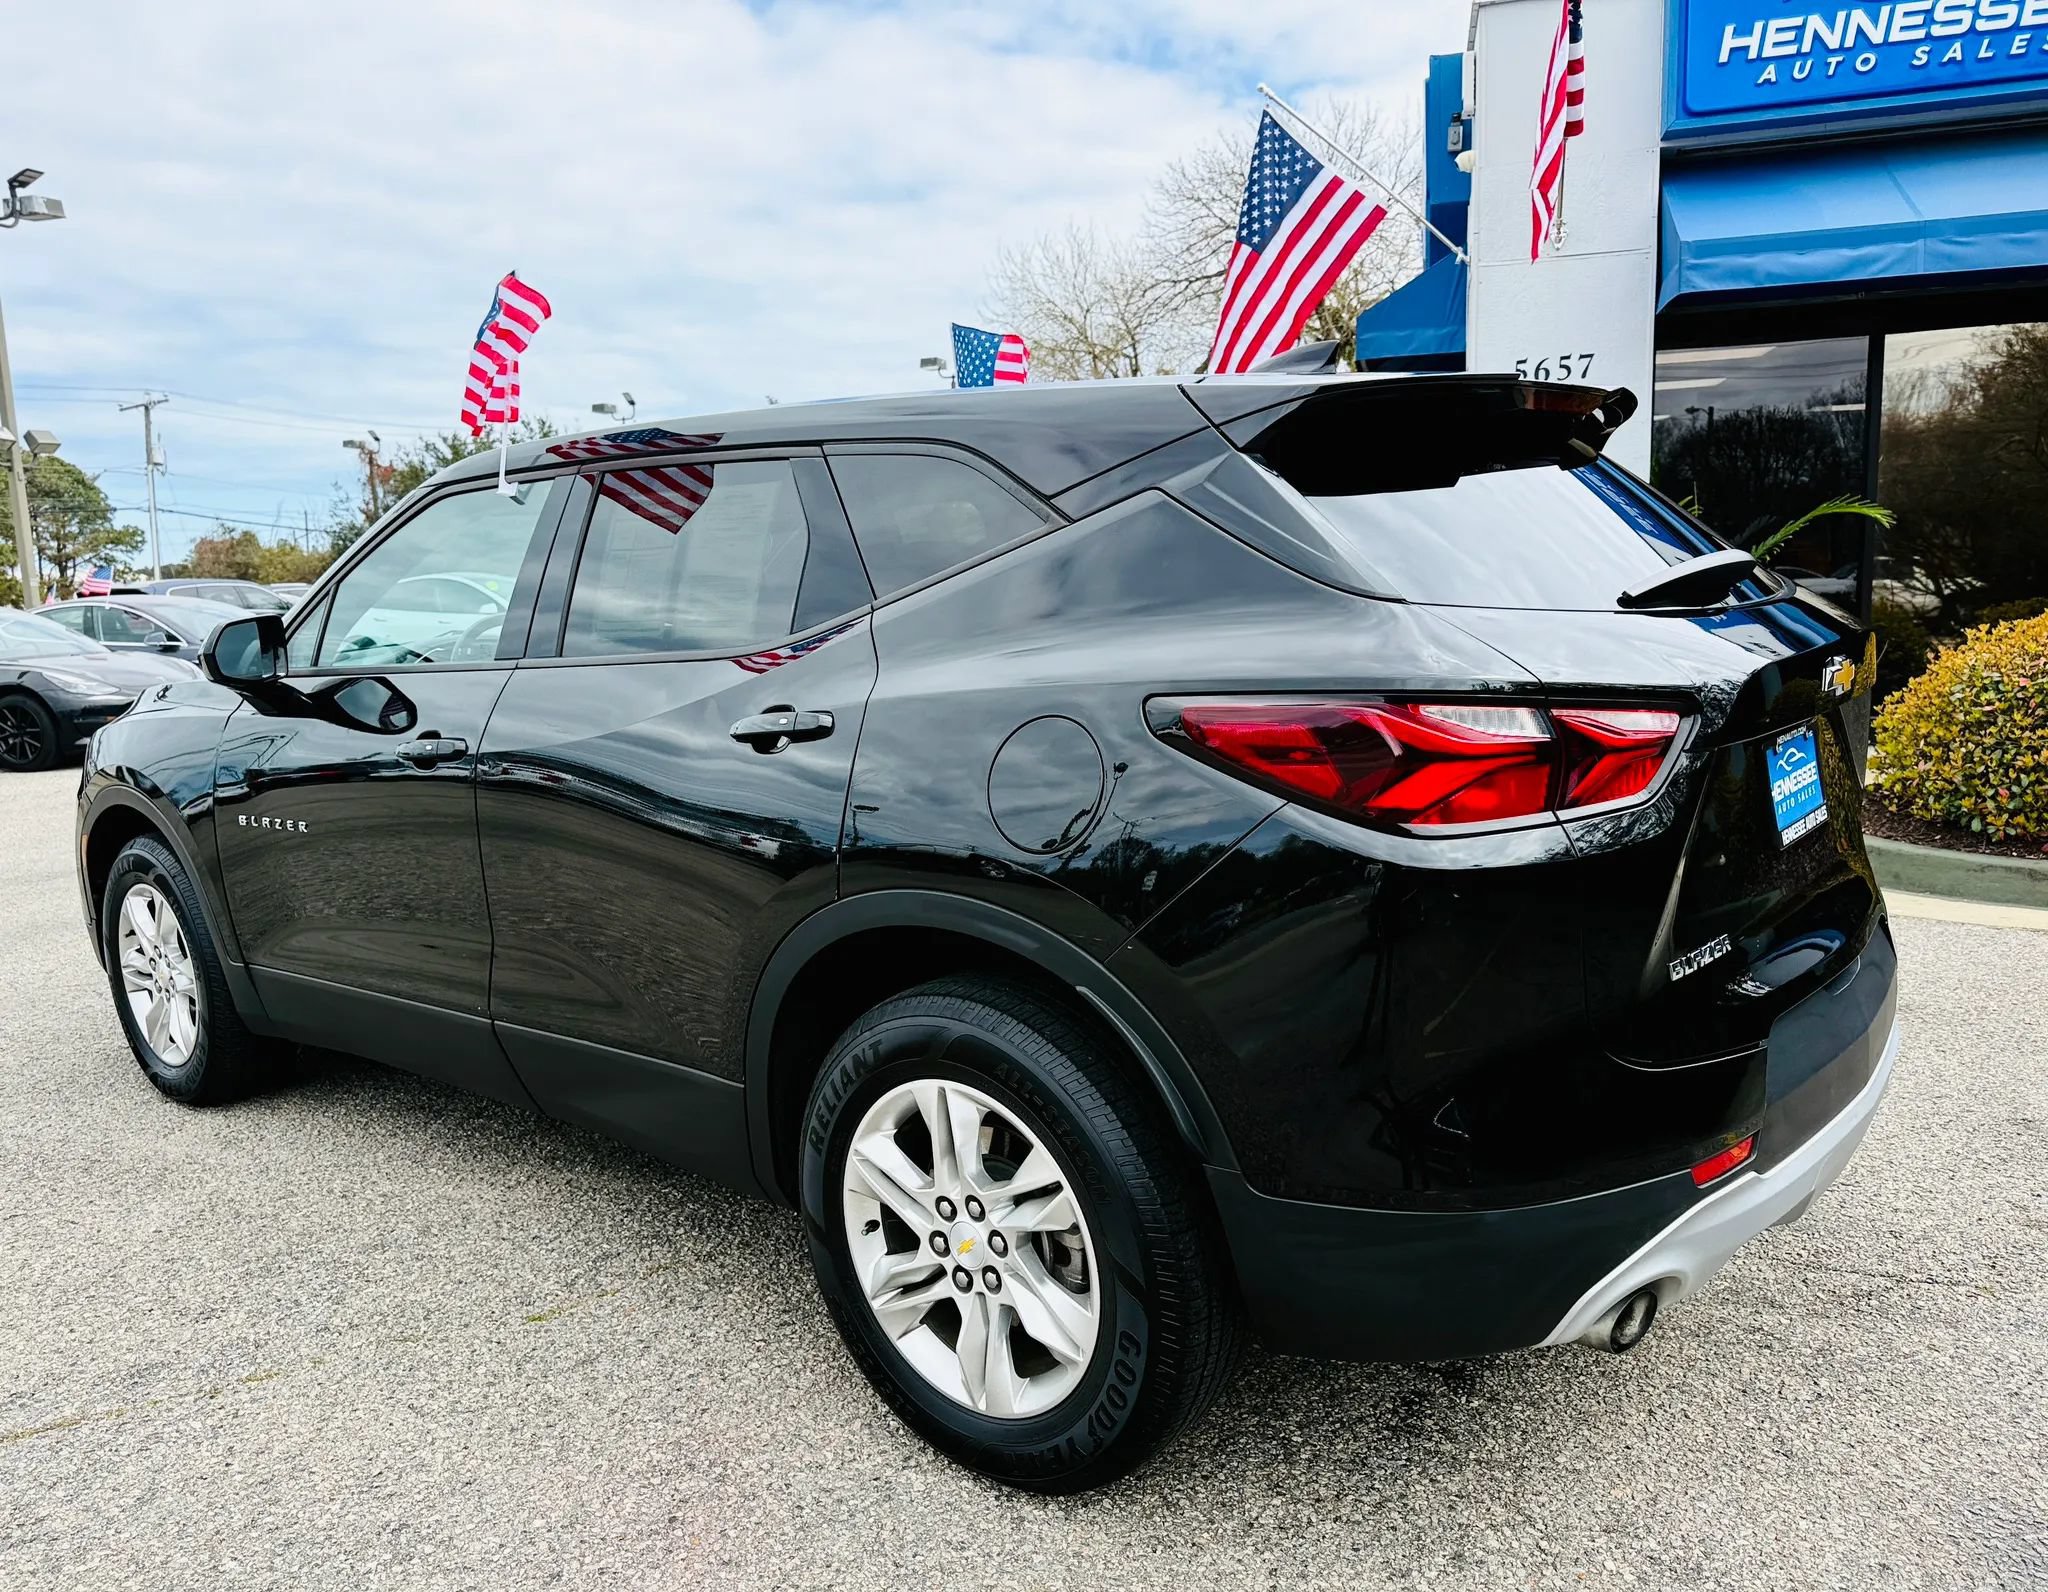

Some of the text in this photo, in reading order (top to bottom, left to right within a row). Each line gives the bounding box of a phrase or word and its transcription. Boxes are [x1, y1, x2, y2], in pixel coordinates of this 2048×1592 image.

[1757, 32, 2048, 84] AUTO SALE
[1514, 353, 1595, 381] 5657
[1771, 761, 1818, 803] HENNESSEE
[1778, 784, 1816, 816] AUTO SALES
[238, 814, 308, 833] BLAZER
[1668, 933, 1732, 982] BLAZER
[808, 1039, 884, 1157] RELIANT
